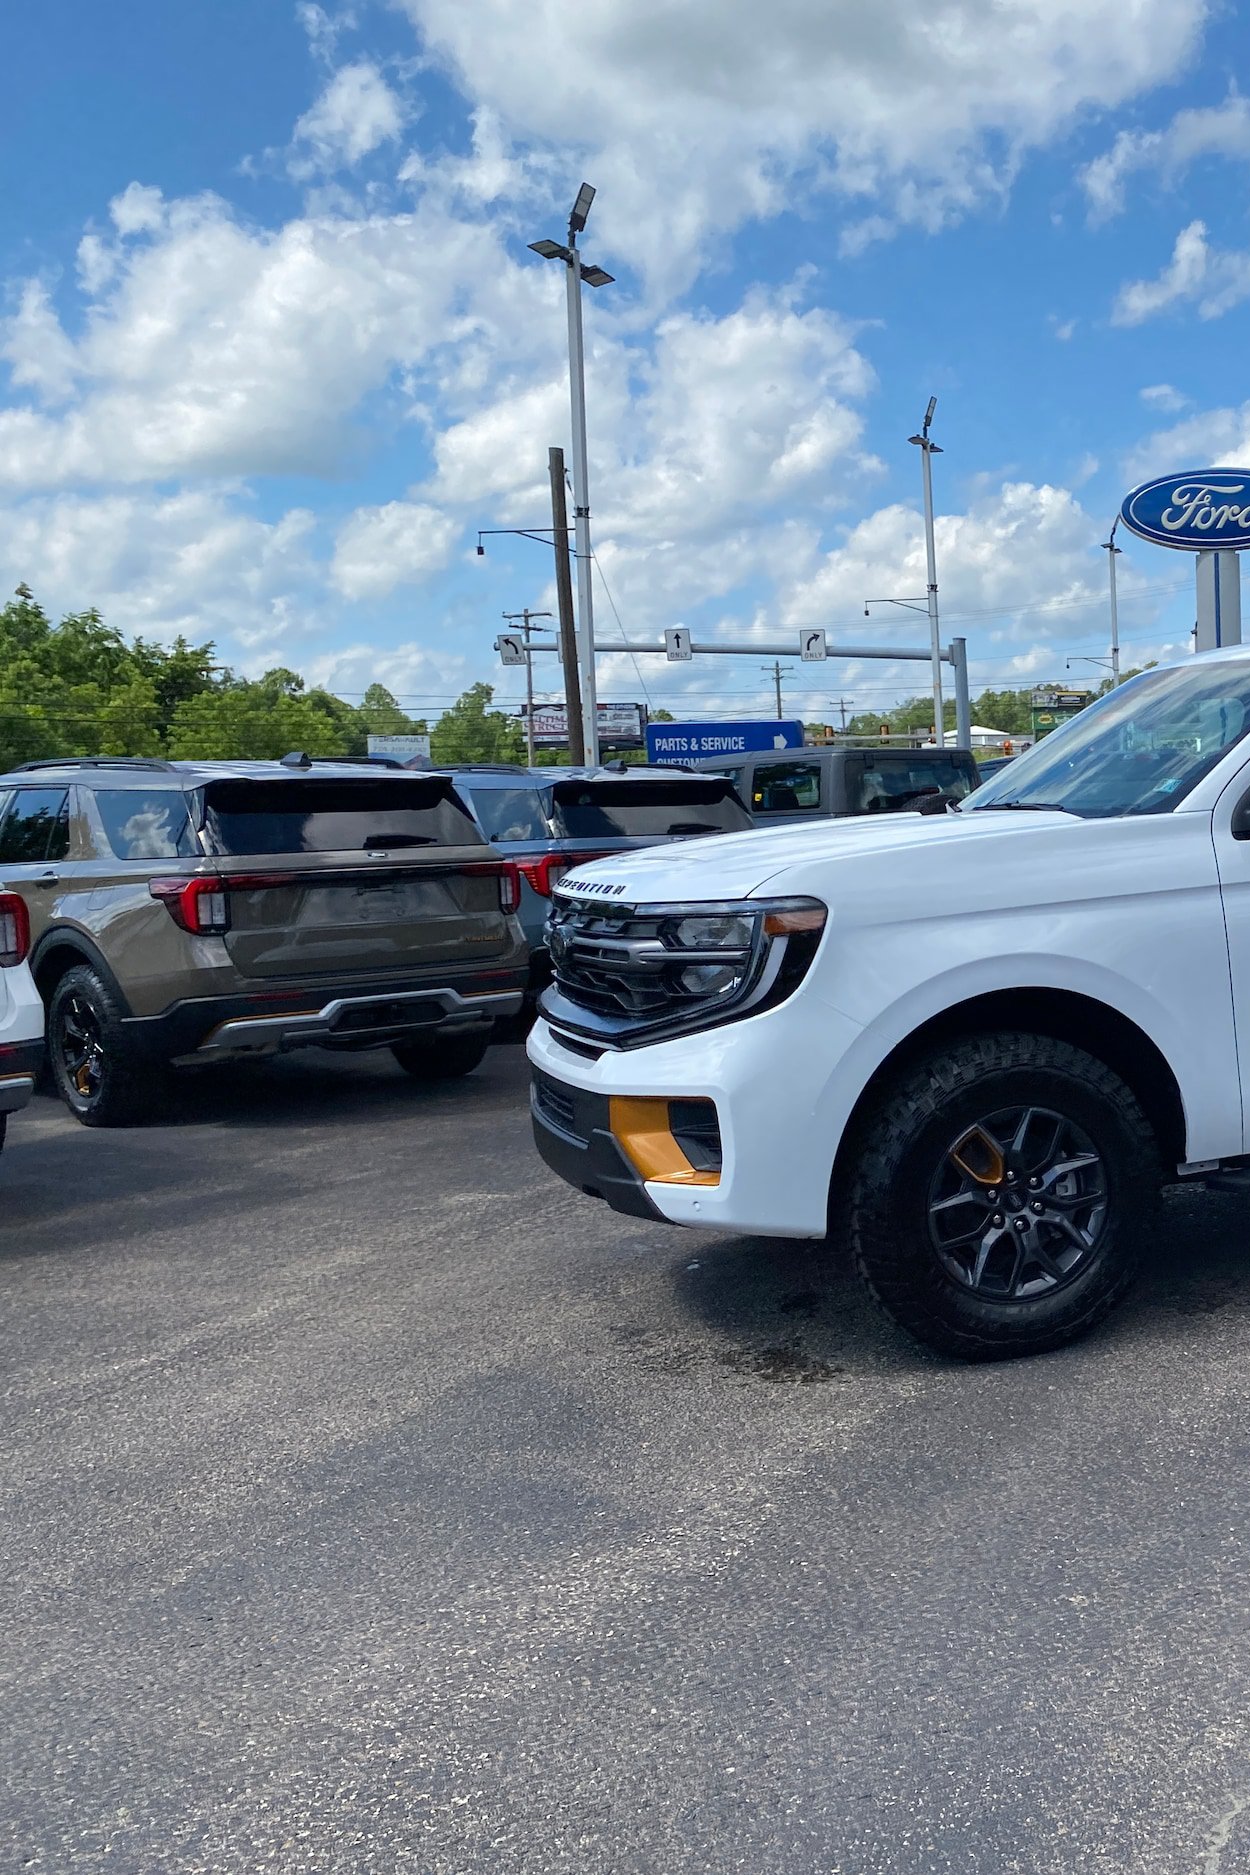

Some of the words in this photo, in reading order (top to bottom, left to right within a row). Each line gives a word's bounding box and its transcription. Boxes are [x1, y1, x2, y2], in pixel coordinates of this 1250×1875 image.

[670, 651, 689, 659] ONLY
[804, 651, 823, 659] ONLY
[655, 737, 688, 752] PARTS
[690, 737, 699, 751] &
[701, 737, 745, 751] SERVICE
[557, 878, 626, 895] EXPEDITION
